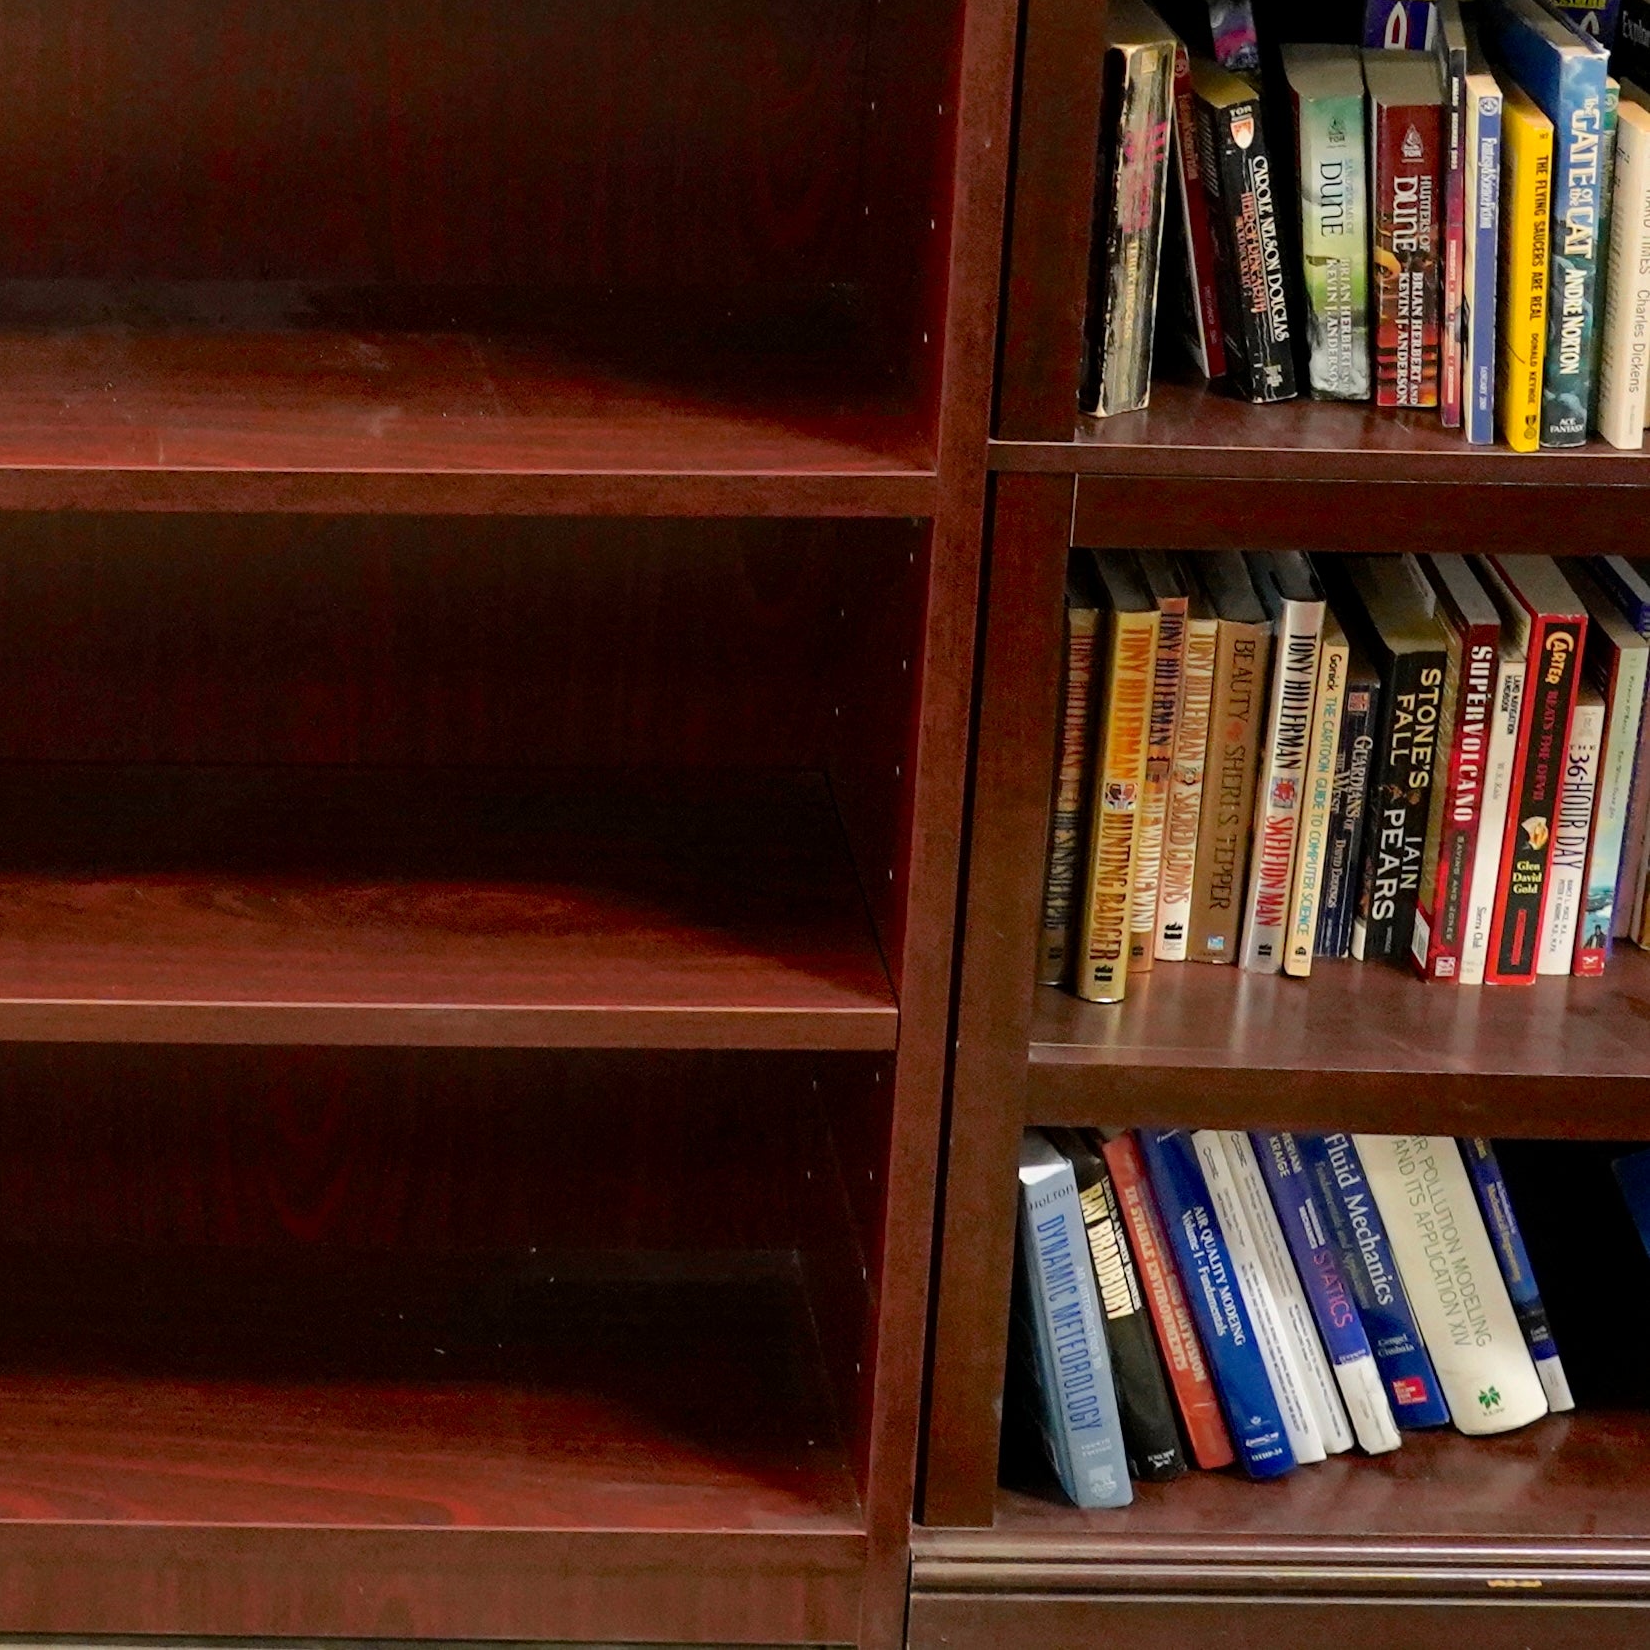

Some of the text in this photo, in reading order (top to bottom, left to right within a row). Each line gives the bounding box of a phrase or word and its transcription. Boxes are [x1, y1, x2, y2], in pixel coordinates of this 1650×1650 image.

[1230, 106, 1252, 117] TOR
[1320, 161, 1345, 238] DUNE
[1393, 176, 1418, 253] DUNE
[1419, 175, 1432, 231] HUNTERS
[1559, 110, 1601, 375] GATE CAT ANDRE NORTON
[1260, 217, 1291, 343] NELSON DOUGLAS
[1529, 155, 1549, 368] THE FLYING SAUCERS ARE REAL DONALD
[1325, 259, 1339, 392] KEVIN ANDERSON
[1339, 257, 1352, 368] BRIAN HERBERT
[1395, 272, 1410, 406] KEVIN ANDERSON
[1409, 272, 1425, 382] BRIAN HERBERT
[1634, 289, 1650, 339] Charles
[1628, 342, 1646, 393] Dickens
[1549, 423, 1585, 434] FANTASY
[1559, 417, 1575, 427] ACE
[1500, 675, 1513, 713] HANDBOOK
[1545, 631, 1575, 685] CARTER
[1389, 694, 1412, 766] FALL
[1408, 668, 1441, 789] STONE'S
[1453, 645, 1492, 822] SUPERVOLCANO
[1507, 694, 1521, 736] NAVIGATION
[1088, 624, 1153, 961] TONY HILLERMAN HUNTING BADGER
[1130, 611, 1185, 933] TONY HILLERMAN WAILING WIND
[1163, 633, 1218, 905] TONY HILLERMAN SACRED CLOWNS
[1209, 638, 1256, 911] BEAUTY SHERI TEPPER
[1255, 632, 1317, 928] TONY HILLERMAN SKELETON MAN
[1297, 652, 1343, 936] Gonick THE CARTOON GUIDE TO COMPUTER SCIENCE
[1345, 735, 1373, 819] GUARDIANS
[1556, 753, 1594, 834] 36-HOUR
[1330, 771, 1348, 867] WEST DAVID
[1371, 808, 1406, 920] PEARS
[1400, 836, 1422, 889] IAIN
[1516, 860, 1541, 872] Glen
[1551, 834, 1586, 870] DAY
[1512, 871, 1543, 884] David
[1512, 882, 1538, 895] Gold
[1269, 1136, 1291, 1178] KRAIGE
[1036, 1213, 1078, 1302] DYNAMIC
[1079, 1181, 1135, 1320] RAY BRADBURY
[1194, 1206, 1229, 1284] AIR QUALITY
[1324, 1133, 1360, 1190] Fluid
[1344, 1194, 1395, 1306] Mechanics
[1391, 1138, 1472, 1347] AND ITS APPLICATION XIV
[1416, 1156, 1493, 1350] POLLUTION MODELING
[1130, 1206, 1154, 1260] STABLE
[1146, 1260, 1188, 1372] ENVIRONMENTS
[1182, 1209, 1227, 1337] Volume Fundamentals
[1313, 1250, 1354, 1329] STATICS
[1049, 1308, 1104, 1432] METEOROLOGY
